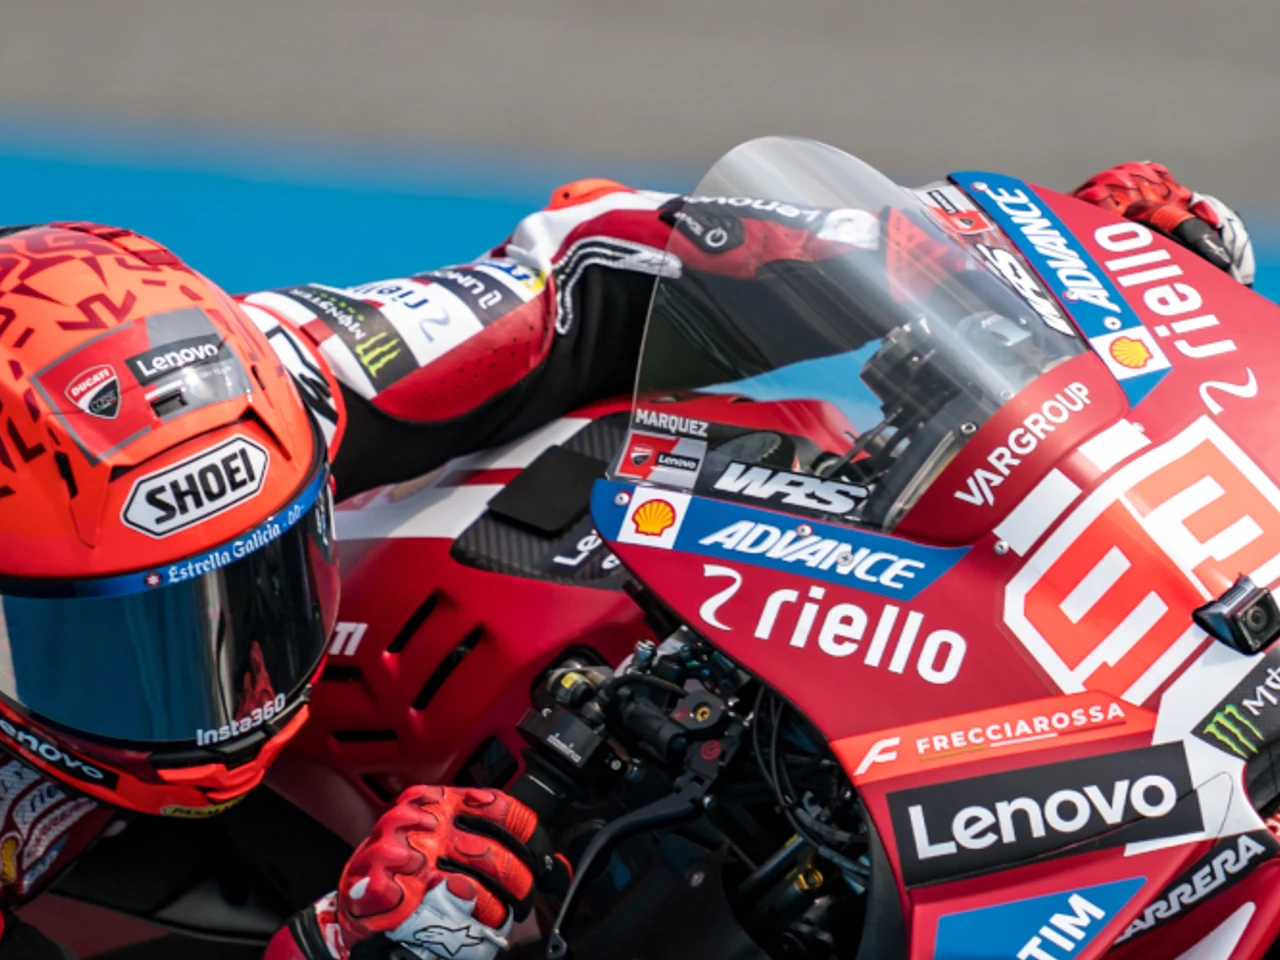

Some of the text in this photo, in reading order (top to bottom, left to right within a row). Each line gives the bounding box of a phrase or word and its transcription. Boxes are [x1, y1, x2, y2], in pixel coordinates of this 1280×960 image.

[985, 188, 1122, 313] ADVANCE
[1093, 222, 1237, 359] riello
[71, 370, 110, 397] DUCATI
[136, 343, 218, 377] Lenovo
[635, 408, 708, 437] MARQUEZ
[146, 447, 256, 525] SHOEI
[658, 454, 697, 469] Lenovo
[713, 462, 871, 515] WRS
[168, 551, 231, 583] Estrella
[232, 523, 281, 558] Galicia
[699, 520, 926, 590] ADVANCE
[753, 586, 968, 685] riello
[196, 692, 287, 748] Insta360
[915, 702, 1126, 756] FRECCIAROSSA
[907, 773, 1178, 861] Lenovo
[1114, 834, 1266, 945] ARRERA
